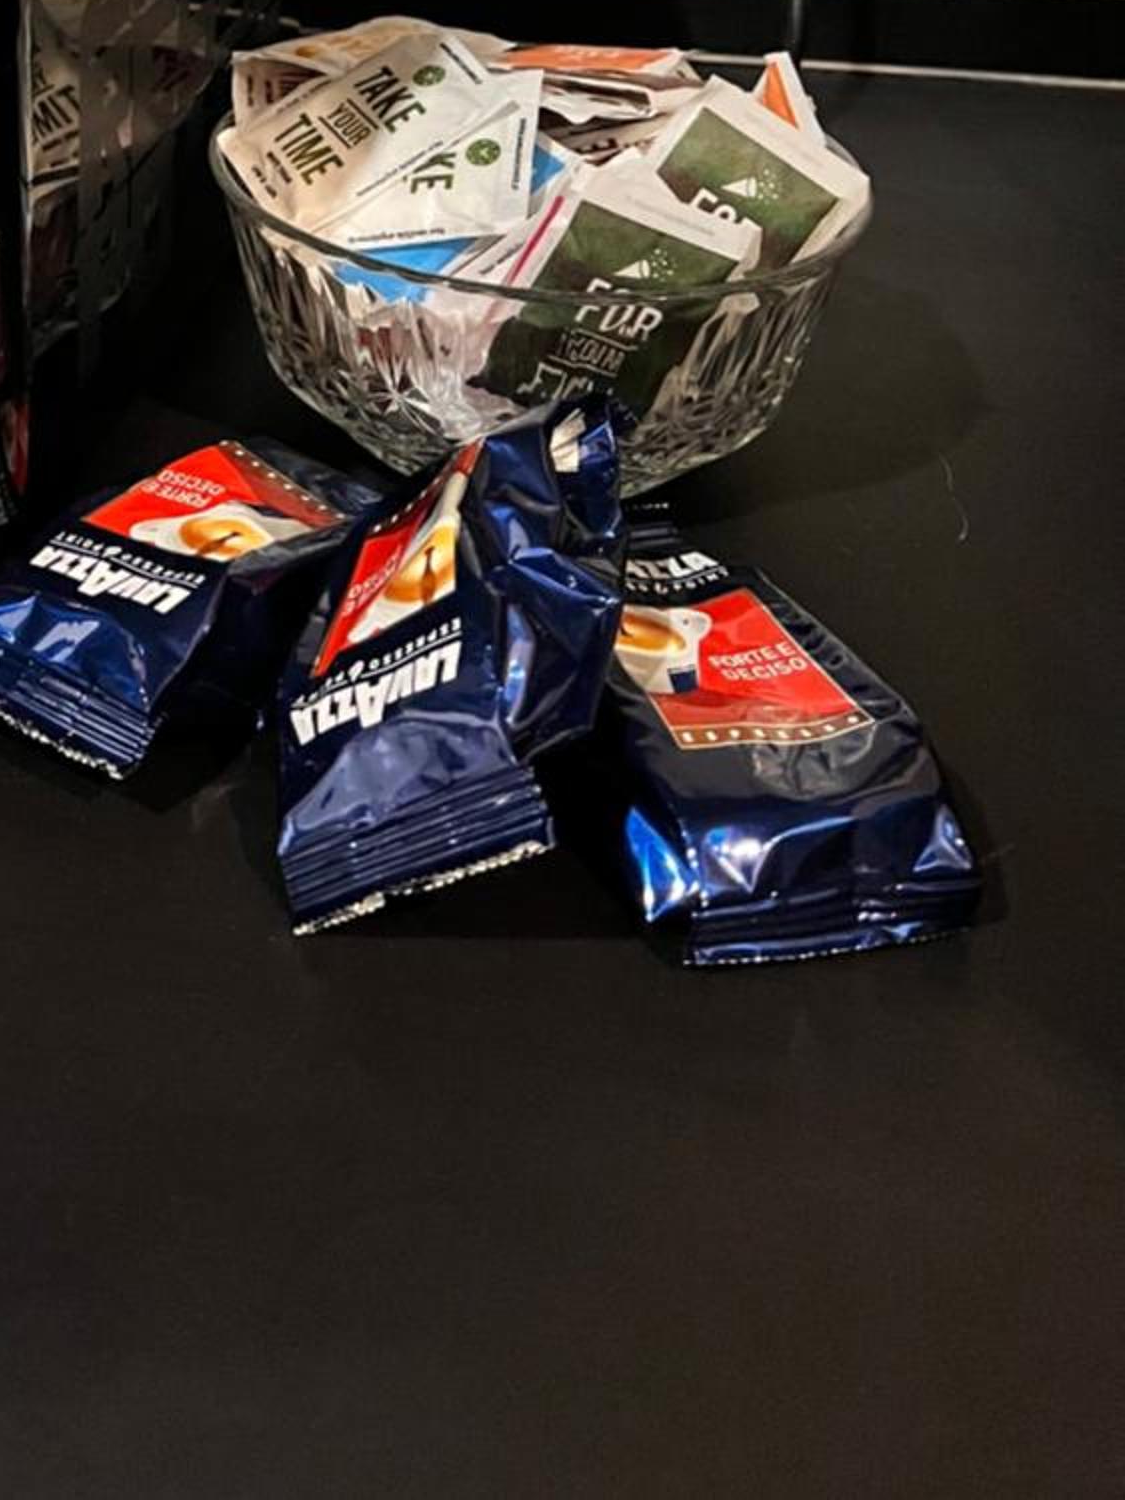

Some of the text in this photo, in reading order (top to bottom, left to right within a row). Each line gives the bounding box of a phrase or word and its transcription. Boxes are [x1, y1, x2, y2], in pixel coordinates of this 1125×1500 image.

[326, 102, 375, 147] YOUR
[354, 66, 426, 134] TAKE
[274, 113, 344, 186] TIME
[404, 152, 456, 194] KE
[30, 546, 192, 615] LAVAZZA
[708, 645, 779, 668] FORTE
[721, 656, 808, 682] DECISO
[289, 640, 463, 746] LAVAZZA
